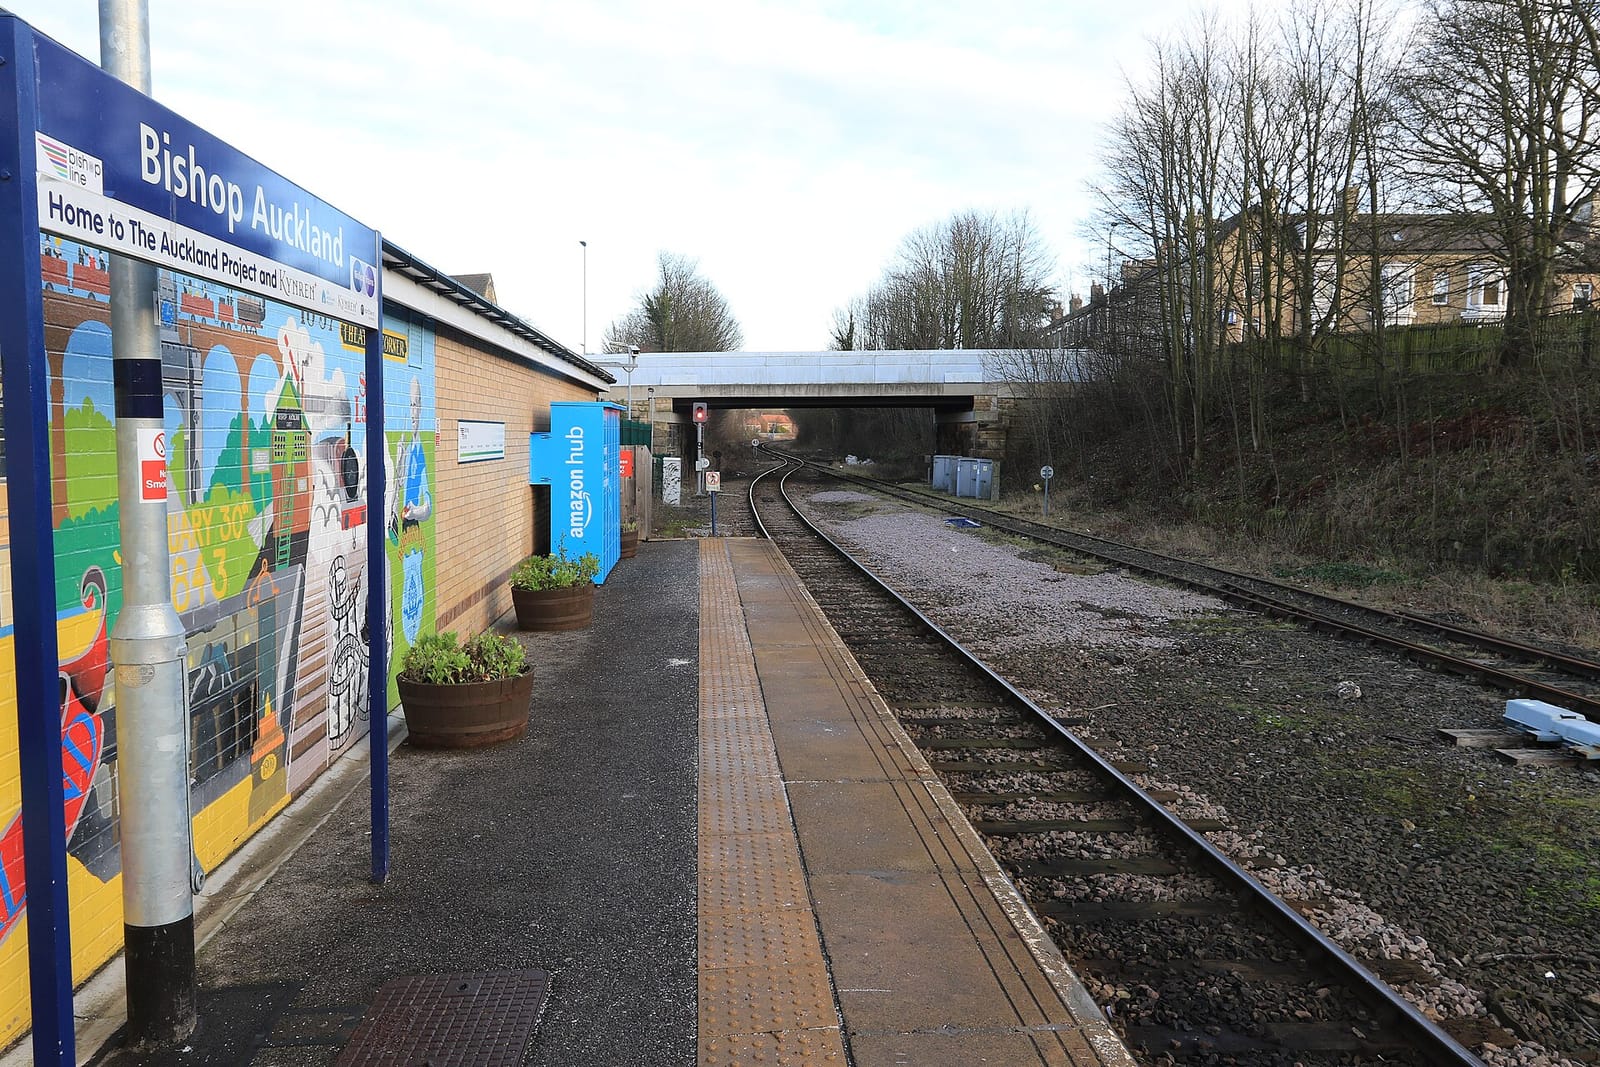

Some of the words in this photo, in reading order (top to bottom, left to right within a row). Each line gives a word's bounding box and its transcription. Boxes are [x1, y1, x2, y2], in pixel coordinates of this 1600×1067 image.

[69, 168, 87, 186] line
[140, 122, 244, 234] Bishop
[251, 185, 343, 268] Auckland
[49, 191, 104, 234] Home
[108, 213, 125, 241] to
[129, 219, 156, 250] The
[161, 231, 218, 270] Auckland
[222, 252, 257, 283] Project
[260, 269, 277, 288] and
[383, 335, 406, 357] ORNER
[565, 426, 584, 464] hub
[570, 469, 585, 538] amazon
[170, 548, 228, 613] 843
